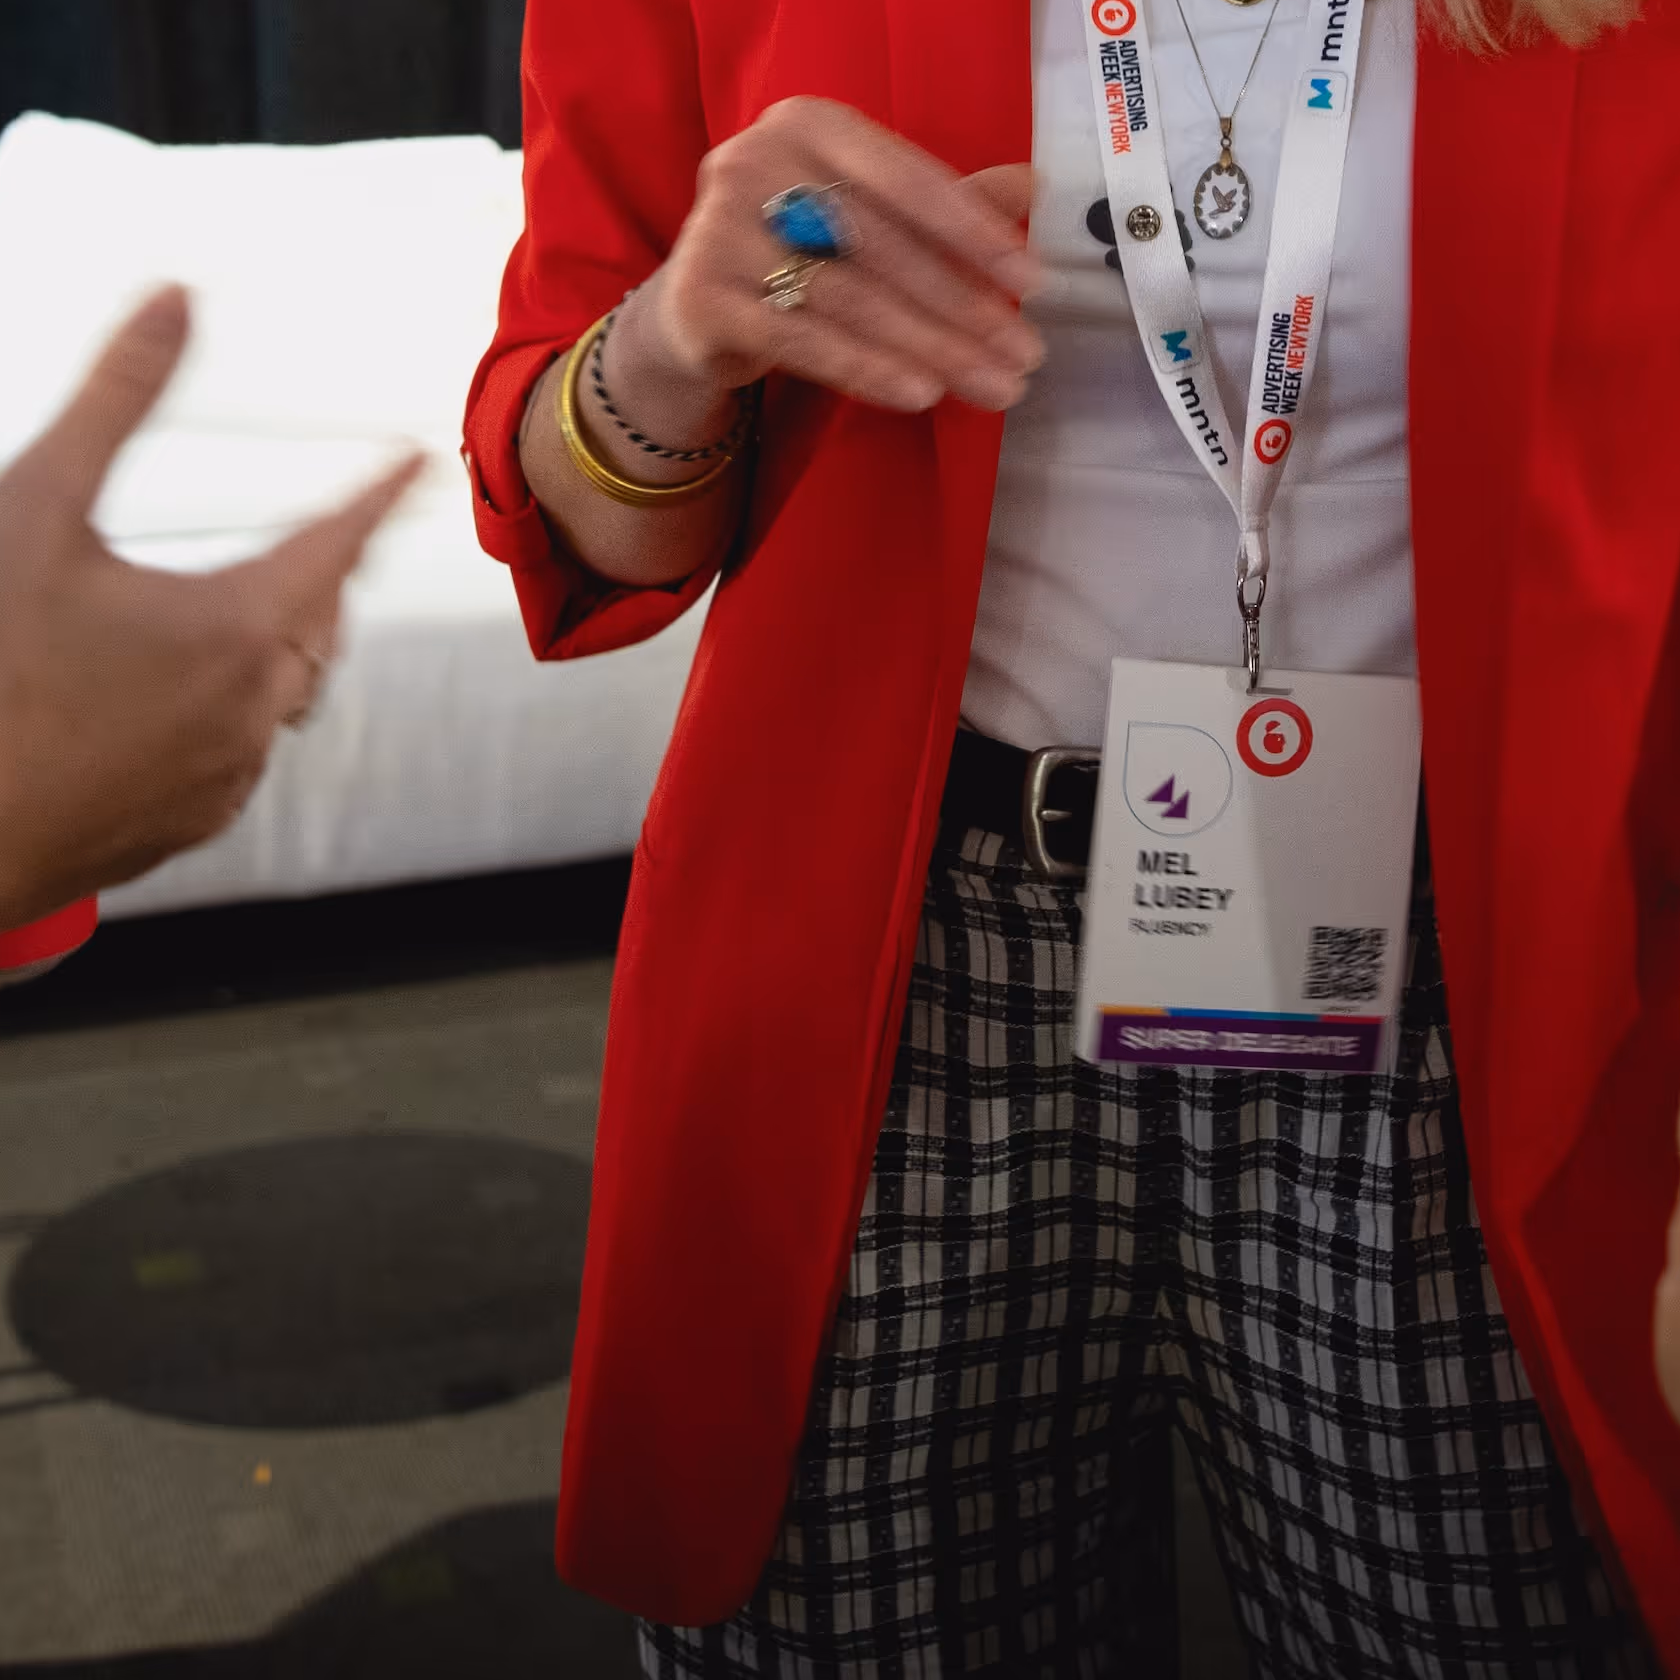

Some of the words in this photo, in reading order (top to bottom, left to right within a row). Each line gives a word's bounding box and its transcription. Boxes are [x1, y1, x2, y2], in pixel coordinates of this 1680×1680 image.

[1099, 40, 1122, 82] WEEK
[1118, 39, 1148, 132] ADVERTISING
[1261, 312, 1292, 414] ADVERTISING
[1280, 370, 1304, 415] WEEK
[1175, 377, 1228, 466] mntn
[1137, 850, 1198, 876] MEL
[1134, 883, 1235, 911] LUBEY
